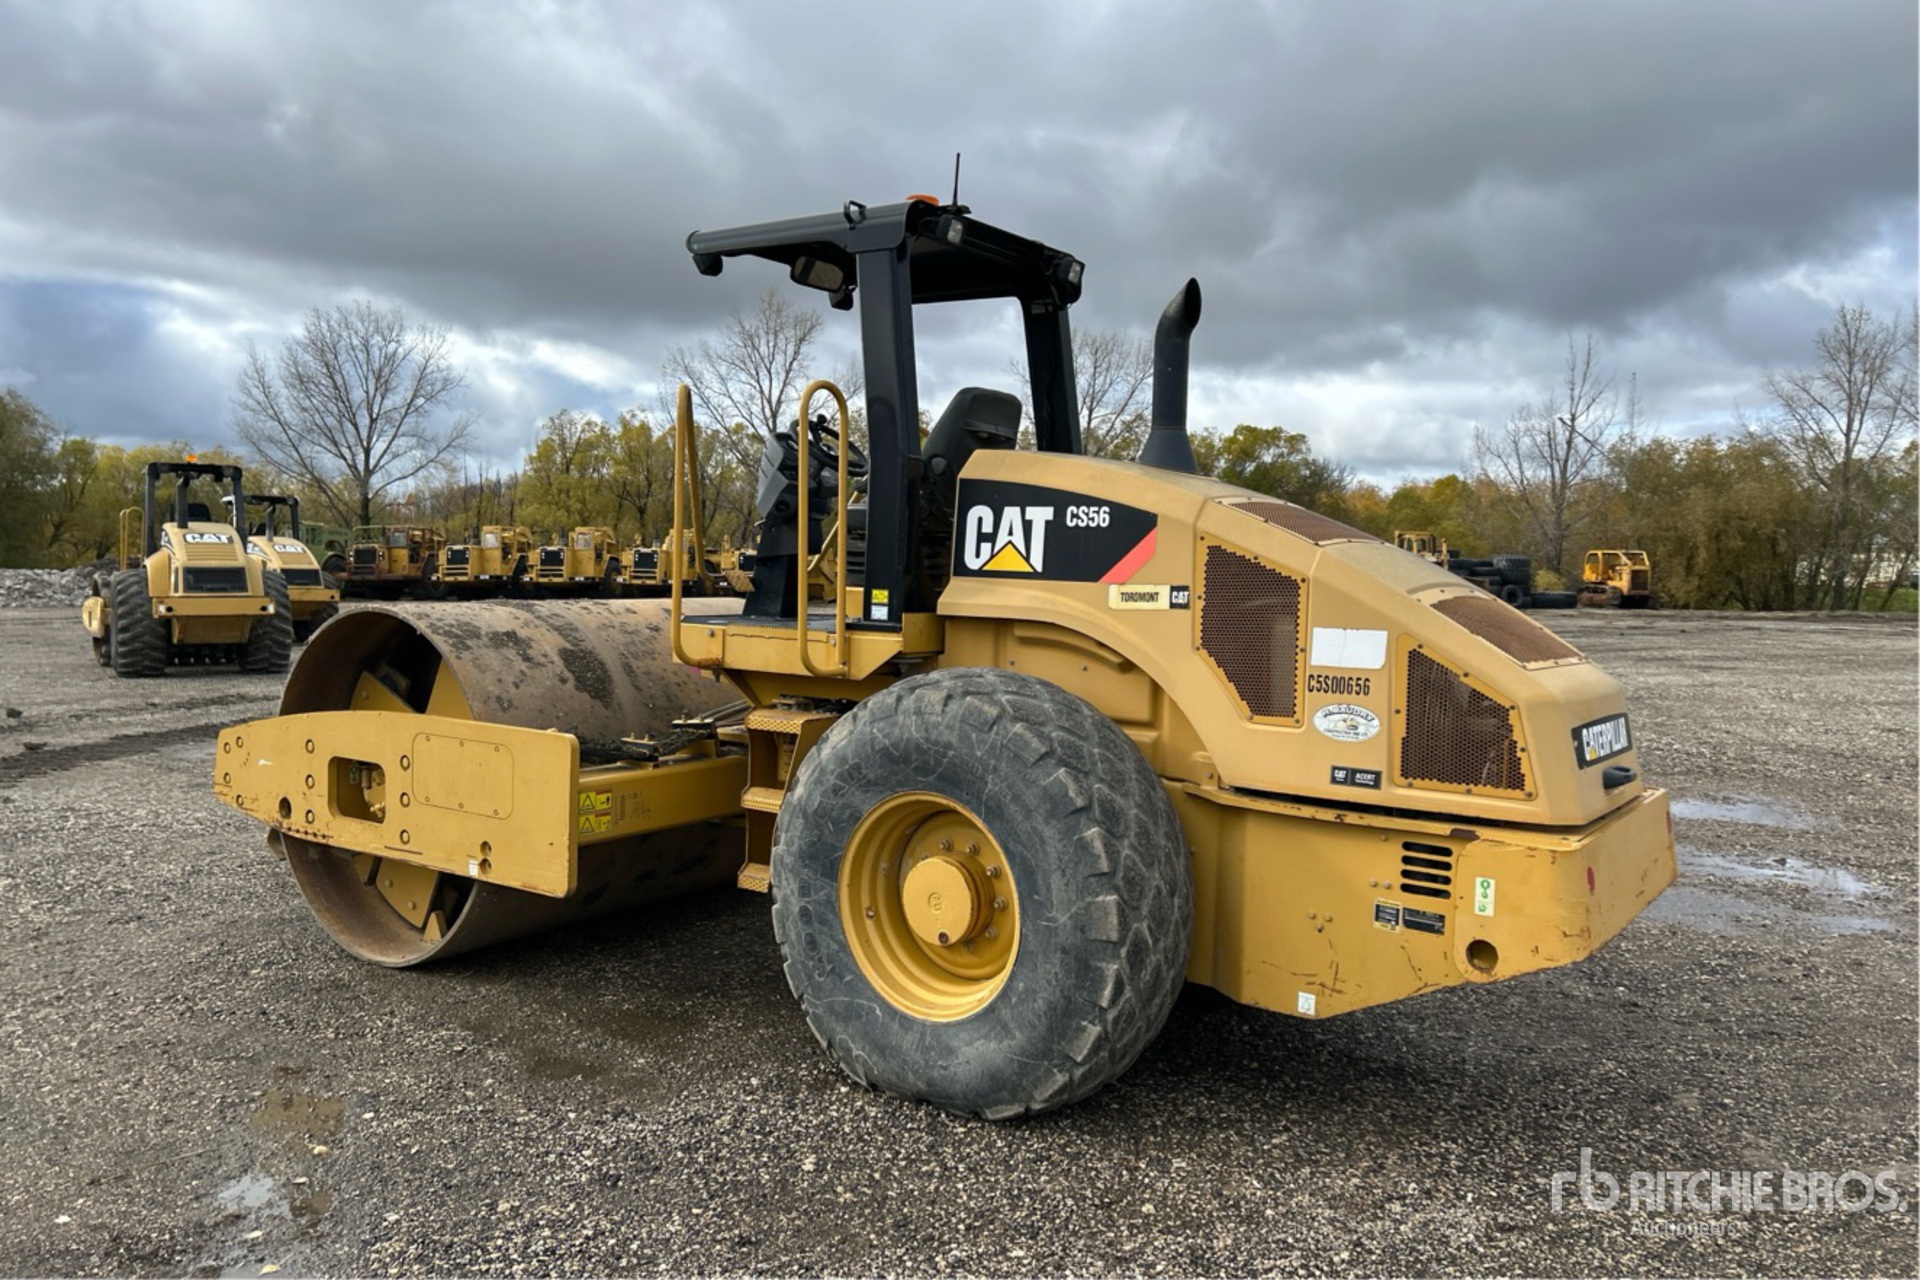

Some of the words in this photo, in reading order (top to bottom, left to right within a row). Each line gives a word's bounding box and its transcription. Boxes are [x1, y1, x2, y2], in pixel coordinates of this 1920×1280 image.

[1066, 505, 1110, 528] CS56
[184, 533, 230, 544] CAT
[964, 504, 1054, 573] CAT
[1120, 592, 1160, 603] TOROMONT
[1171, 591, 1190, 604] CAT
[1307, 673, 1371, 696] C5S00656
